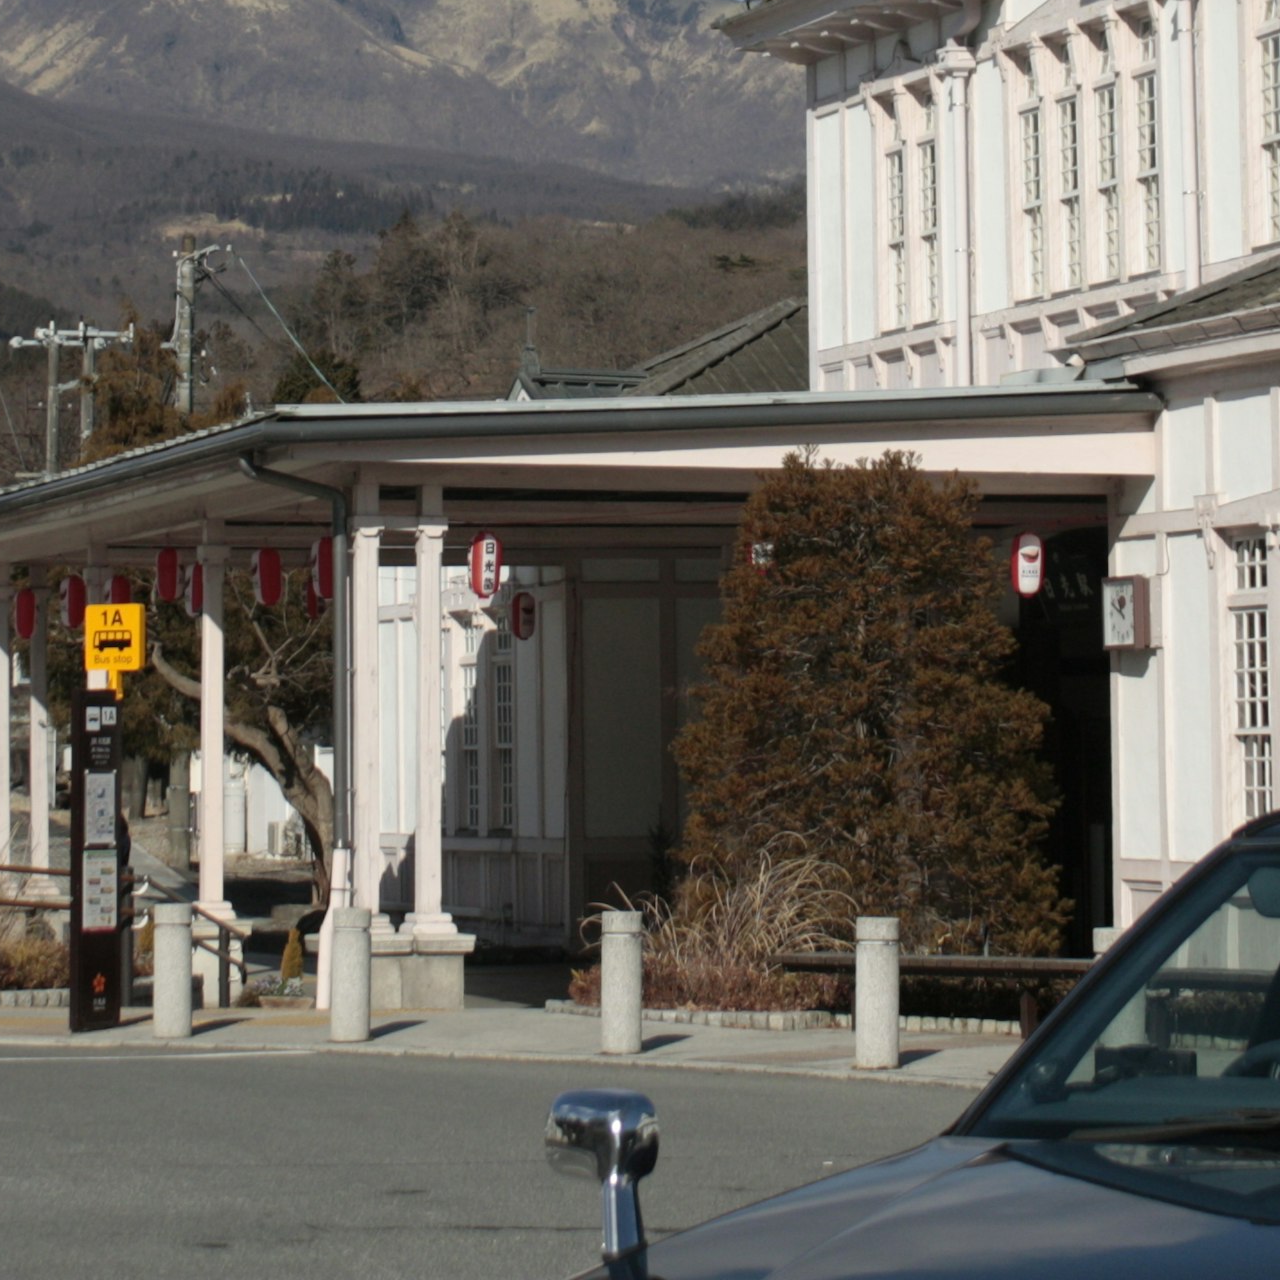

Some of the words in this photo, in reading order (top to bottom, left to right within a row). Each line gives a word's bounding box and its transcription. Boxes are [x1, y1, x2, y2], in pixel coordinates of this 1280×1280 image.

[101, 609, 123, 626] 1A
[94, 654, 110, 664] Bus
[113, 654, 133, 665] stop
